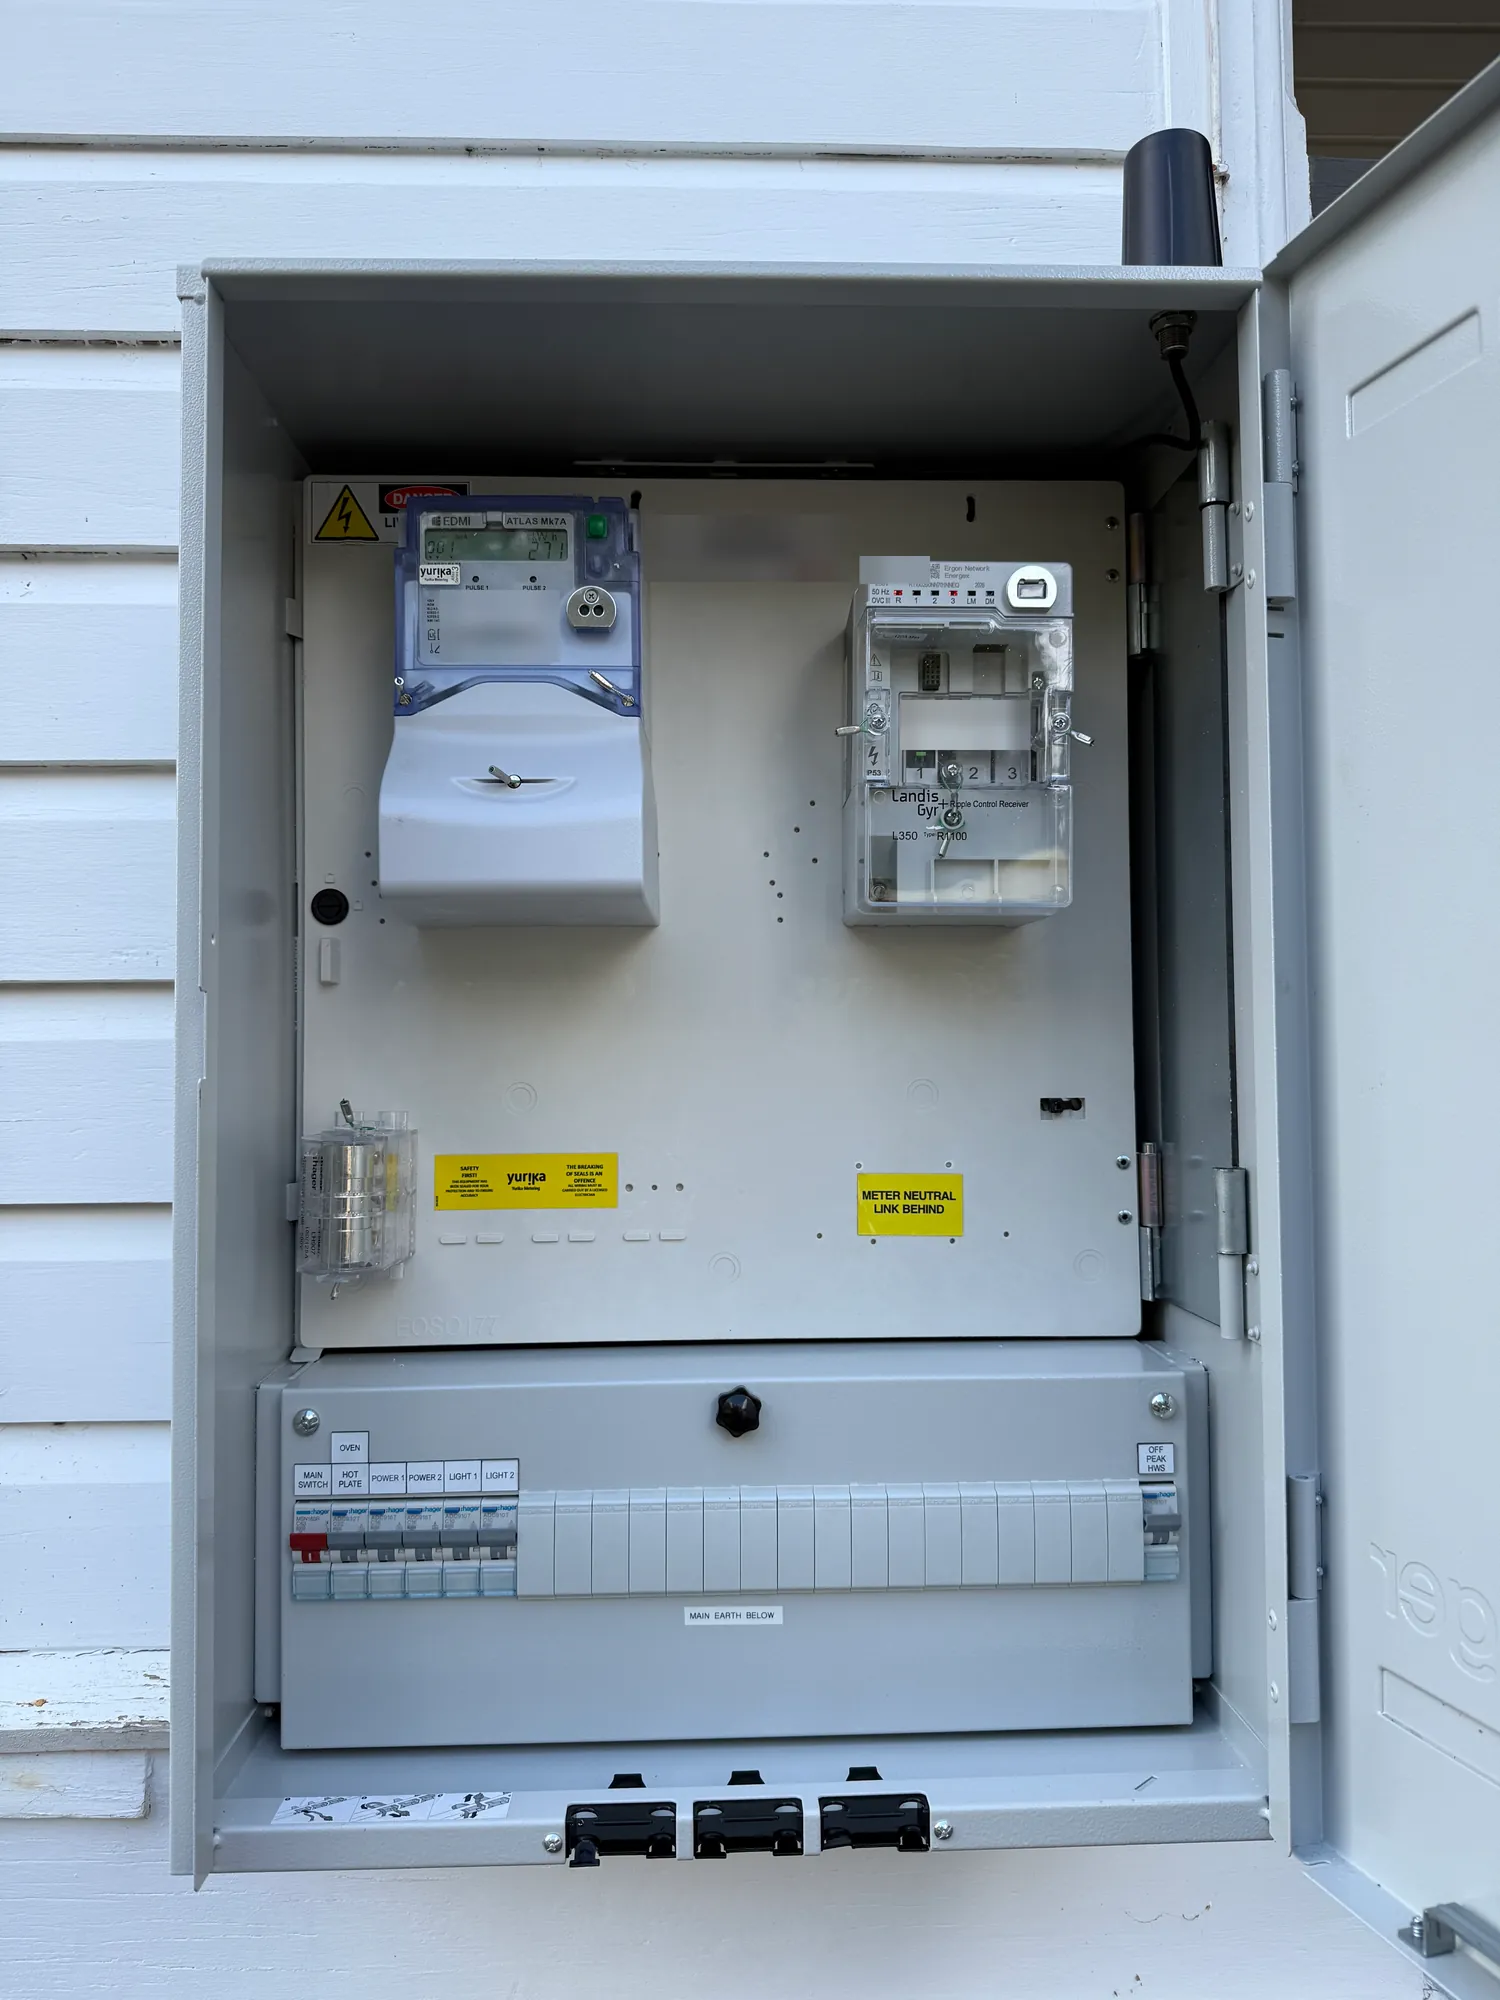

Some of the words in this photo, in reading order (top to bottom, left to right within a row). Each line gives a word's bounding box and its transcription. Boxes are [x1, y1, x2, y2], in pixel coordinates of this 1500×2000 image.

[443, 517, 471, 526] EDMI
[506, 517, 538, 525] ATLAS
[541, 517, 567, 525] Mk7A
[528, 542, 564, 560] 271
[420, 567, 452, 579] yurika
[944, 565, 963, 573] Ergon
[917, 767, 923, 779] 1
[969, 767, 979, 779] 2
[1007, 767, 1017, 779] 3
[892, 789, 939, 803] Landis
[972, 800, 998, 808] Control
[917, 803, 939, 820] Gyr
[892, 831, 918, 841] L350
[507, 1172, 546, 1186] yurika
[862, 1191, 900, 1200] METER
[903, 1191, 956, 1201] NEUTRAL
[874, 1204, 899, 1214] LINK
[902, 1204, 944, 1214] BEHIND
[340, 1444, 361, 1452] OVEN
[1147, 1464, 1166, 1472] HWS
[303, 1471, 323, 1479] MAIN
[342, 1470, 359, 1478] HOT
[437, 1473, 442, 1481] 2
[474, 1472, 478, 1480] 1
[298, 1480, 329, 1488] SWITCH
[338, 1480, 362, 1488] PLATE
[689, 1612, 710, 1620] MAIN
[714, 1612, 742, 1620] EARTH
[746, 1611, 775, 1619] BELOW
